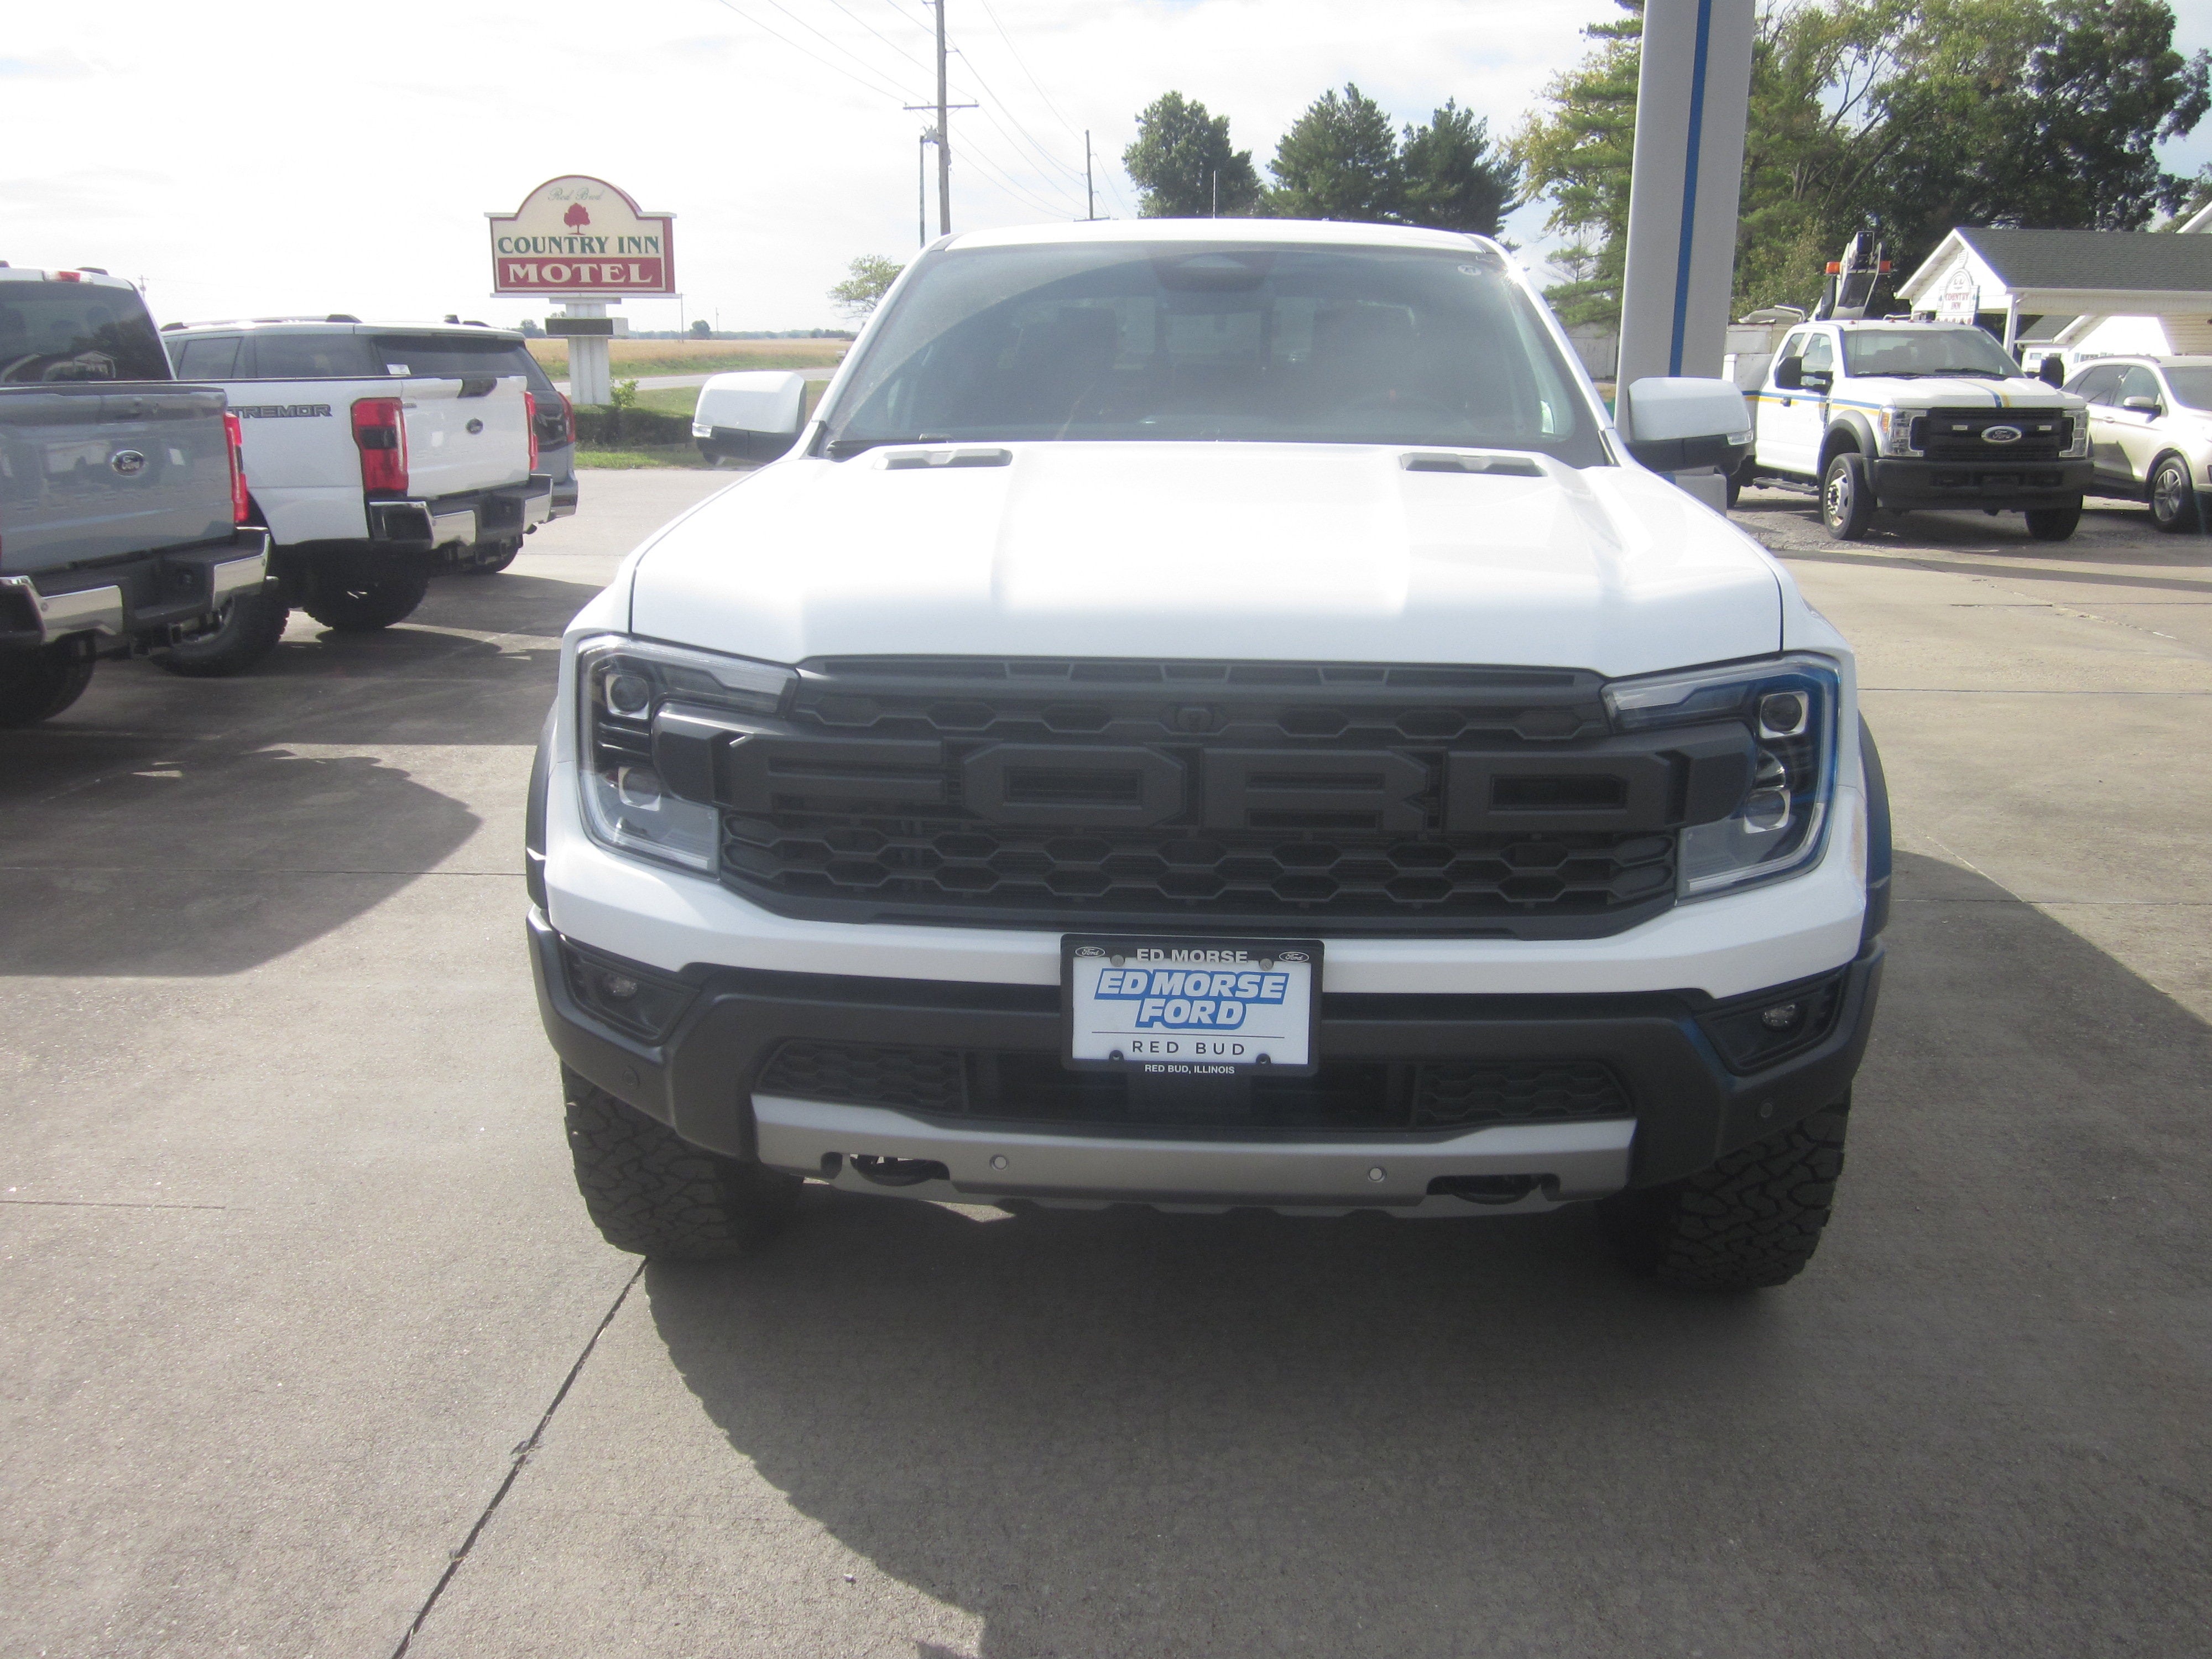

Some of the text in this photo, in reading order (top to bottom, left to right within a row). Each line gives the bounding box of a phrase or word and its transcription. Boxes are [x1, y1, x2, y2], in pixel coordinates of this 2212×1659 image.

[498, 236, 659, 254] COUNTRY INN
[508, 263, 653, 283] MOTEL
[222, 404, 333, 418] TREMOR
[1136, 948, 1248, 964] ED MORSE
[1097, 970, 1286, 999] ED MORSE
[1139, 998, 1243, 1025] FORD
[1132, 1040, 1245, 1055] RED BUD
[1144, 1064, 1235, 1074] RED BUD, ILLINOIS
